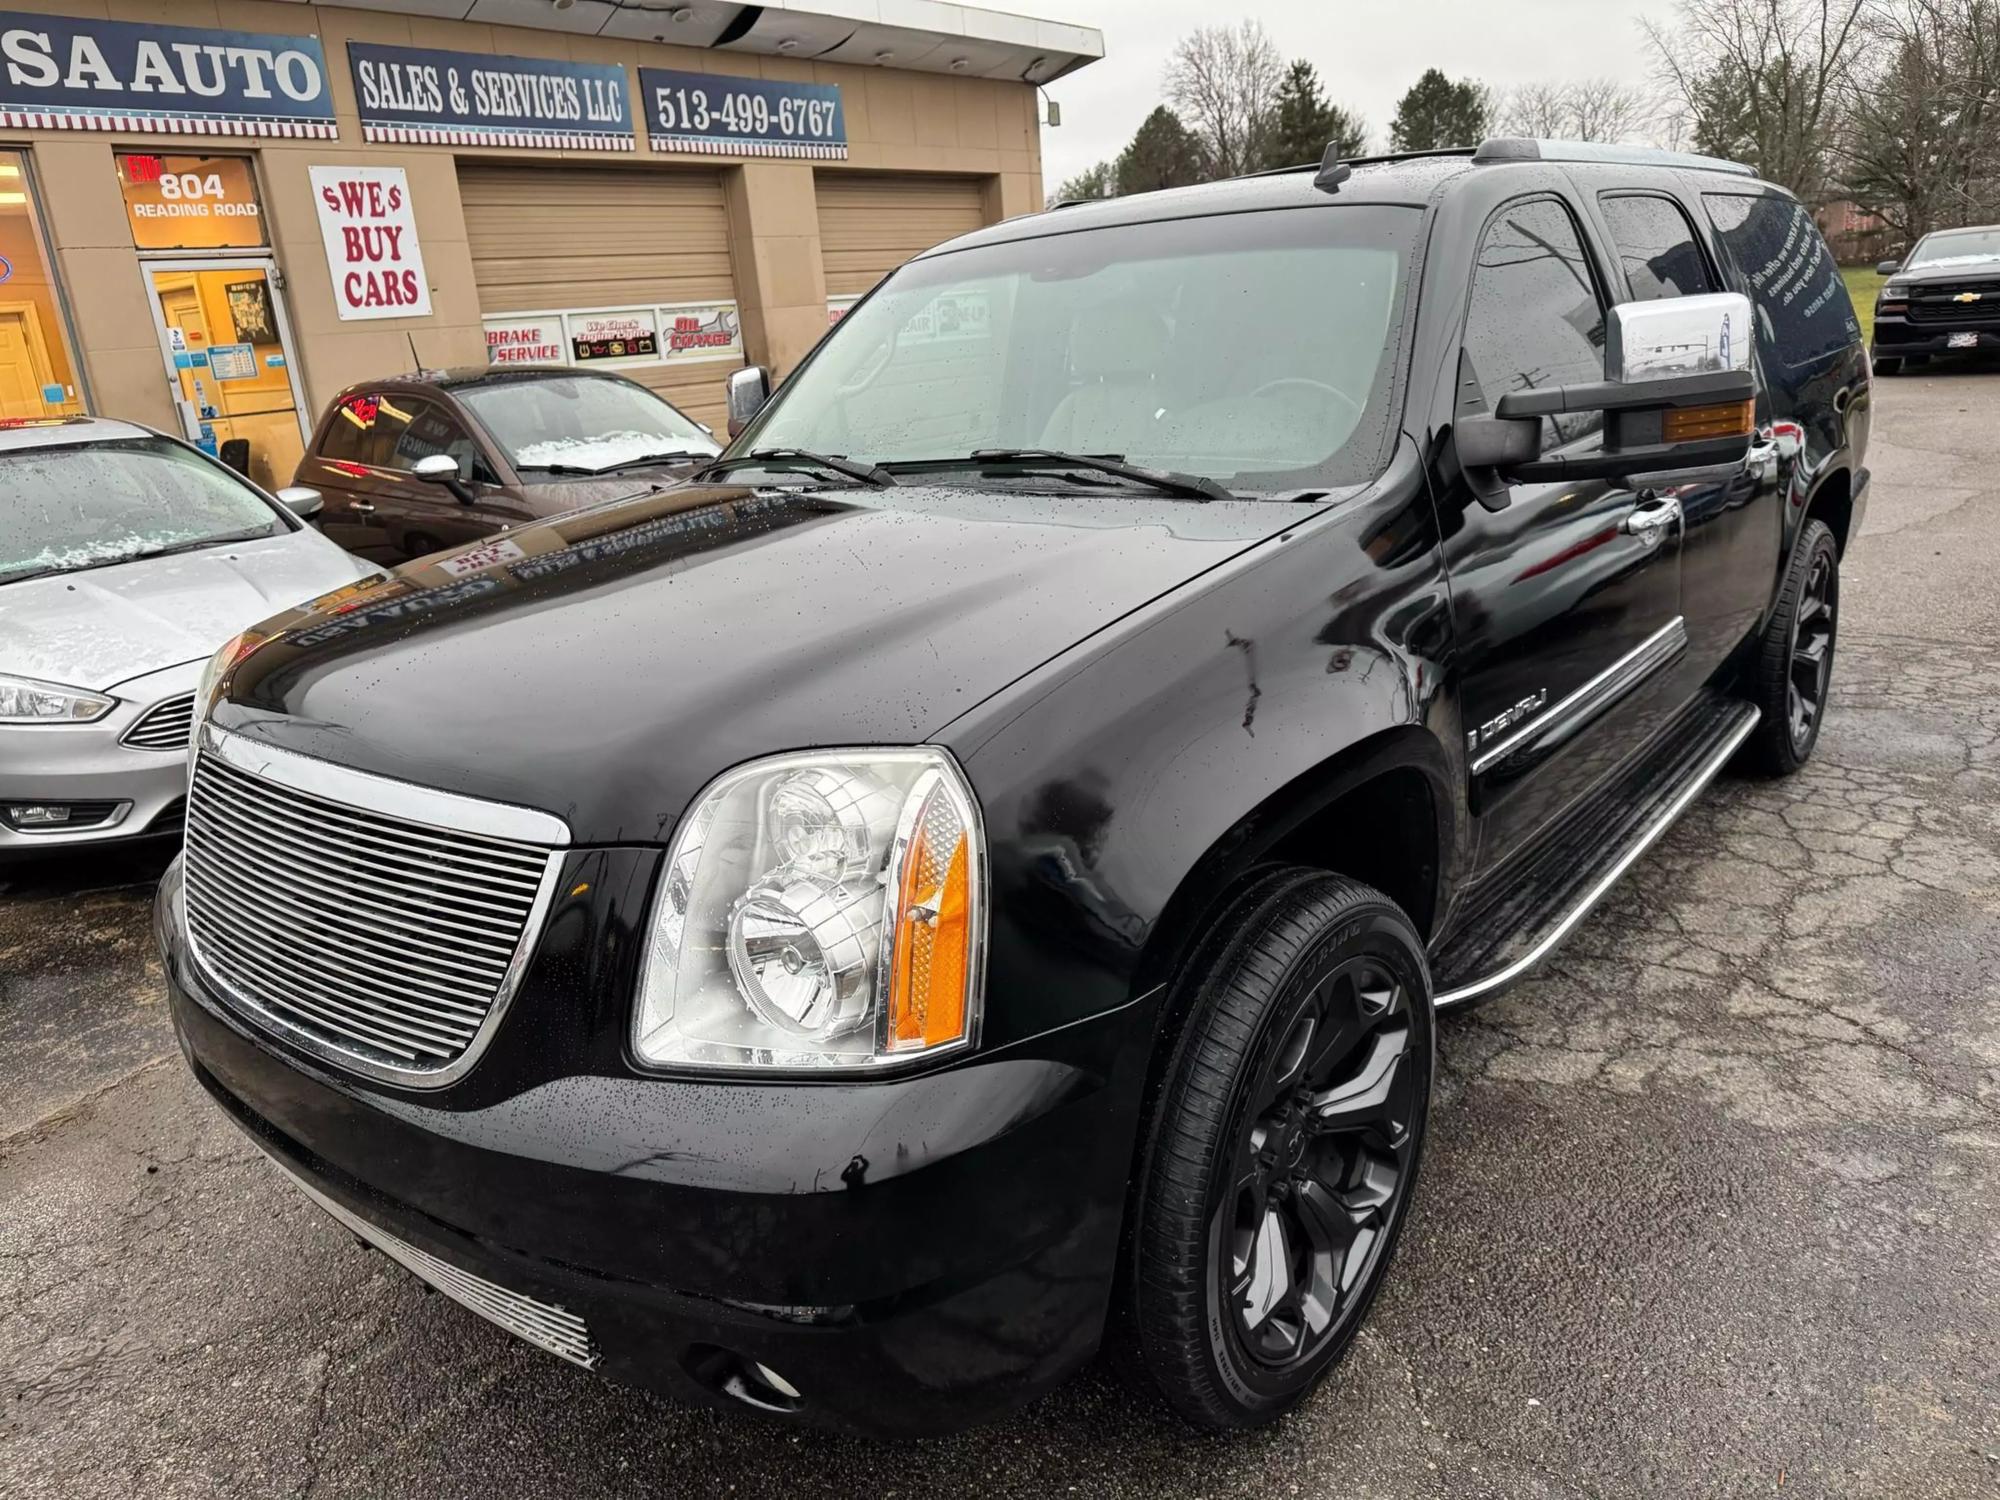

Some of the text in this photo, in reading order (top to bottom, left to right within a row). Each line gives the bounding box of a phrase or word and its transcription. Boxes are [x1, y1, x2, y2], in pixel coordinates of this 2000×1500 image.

[130, 40, 322, 102] AUTO
[359, 59, 622, 123] SALES & SERVICES LLC
[656, 87, 836, 137] 513-499-6767
[158, 173, 224, 200] 804
[133, 203, 259, 218] READING ROAD
[341, 226, 403, 262] BUY
[344, 269, 418, 308] CARS
[487, 328, 541, 345] BRAKE
[675, 316, 703, 334] OIL
[498, 344, 560, 362] SERVICE
